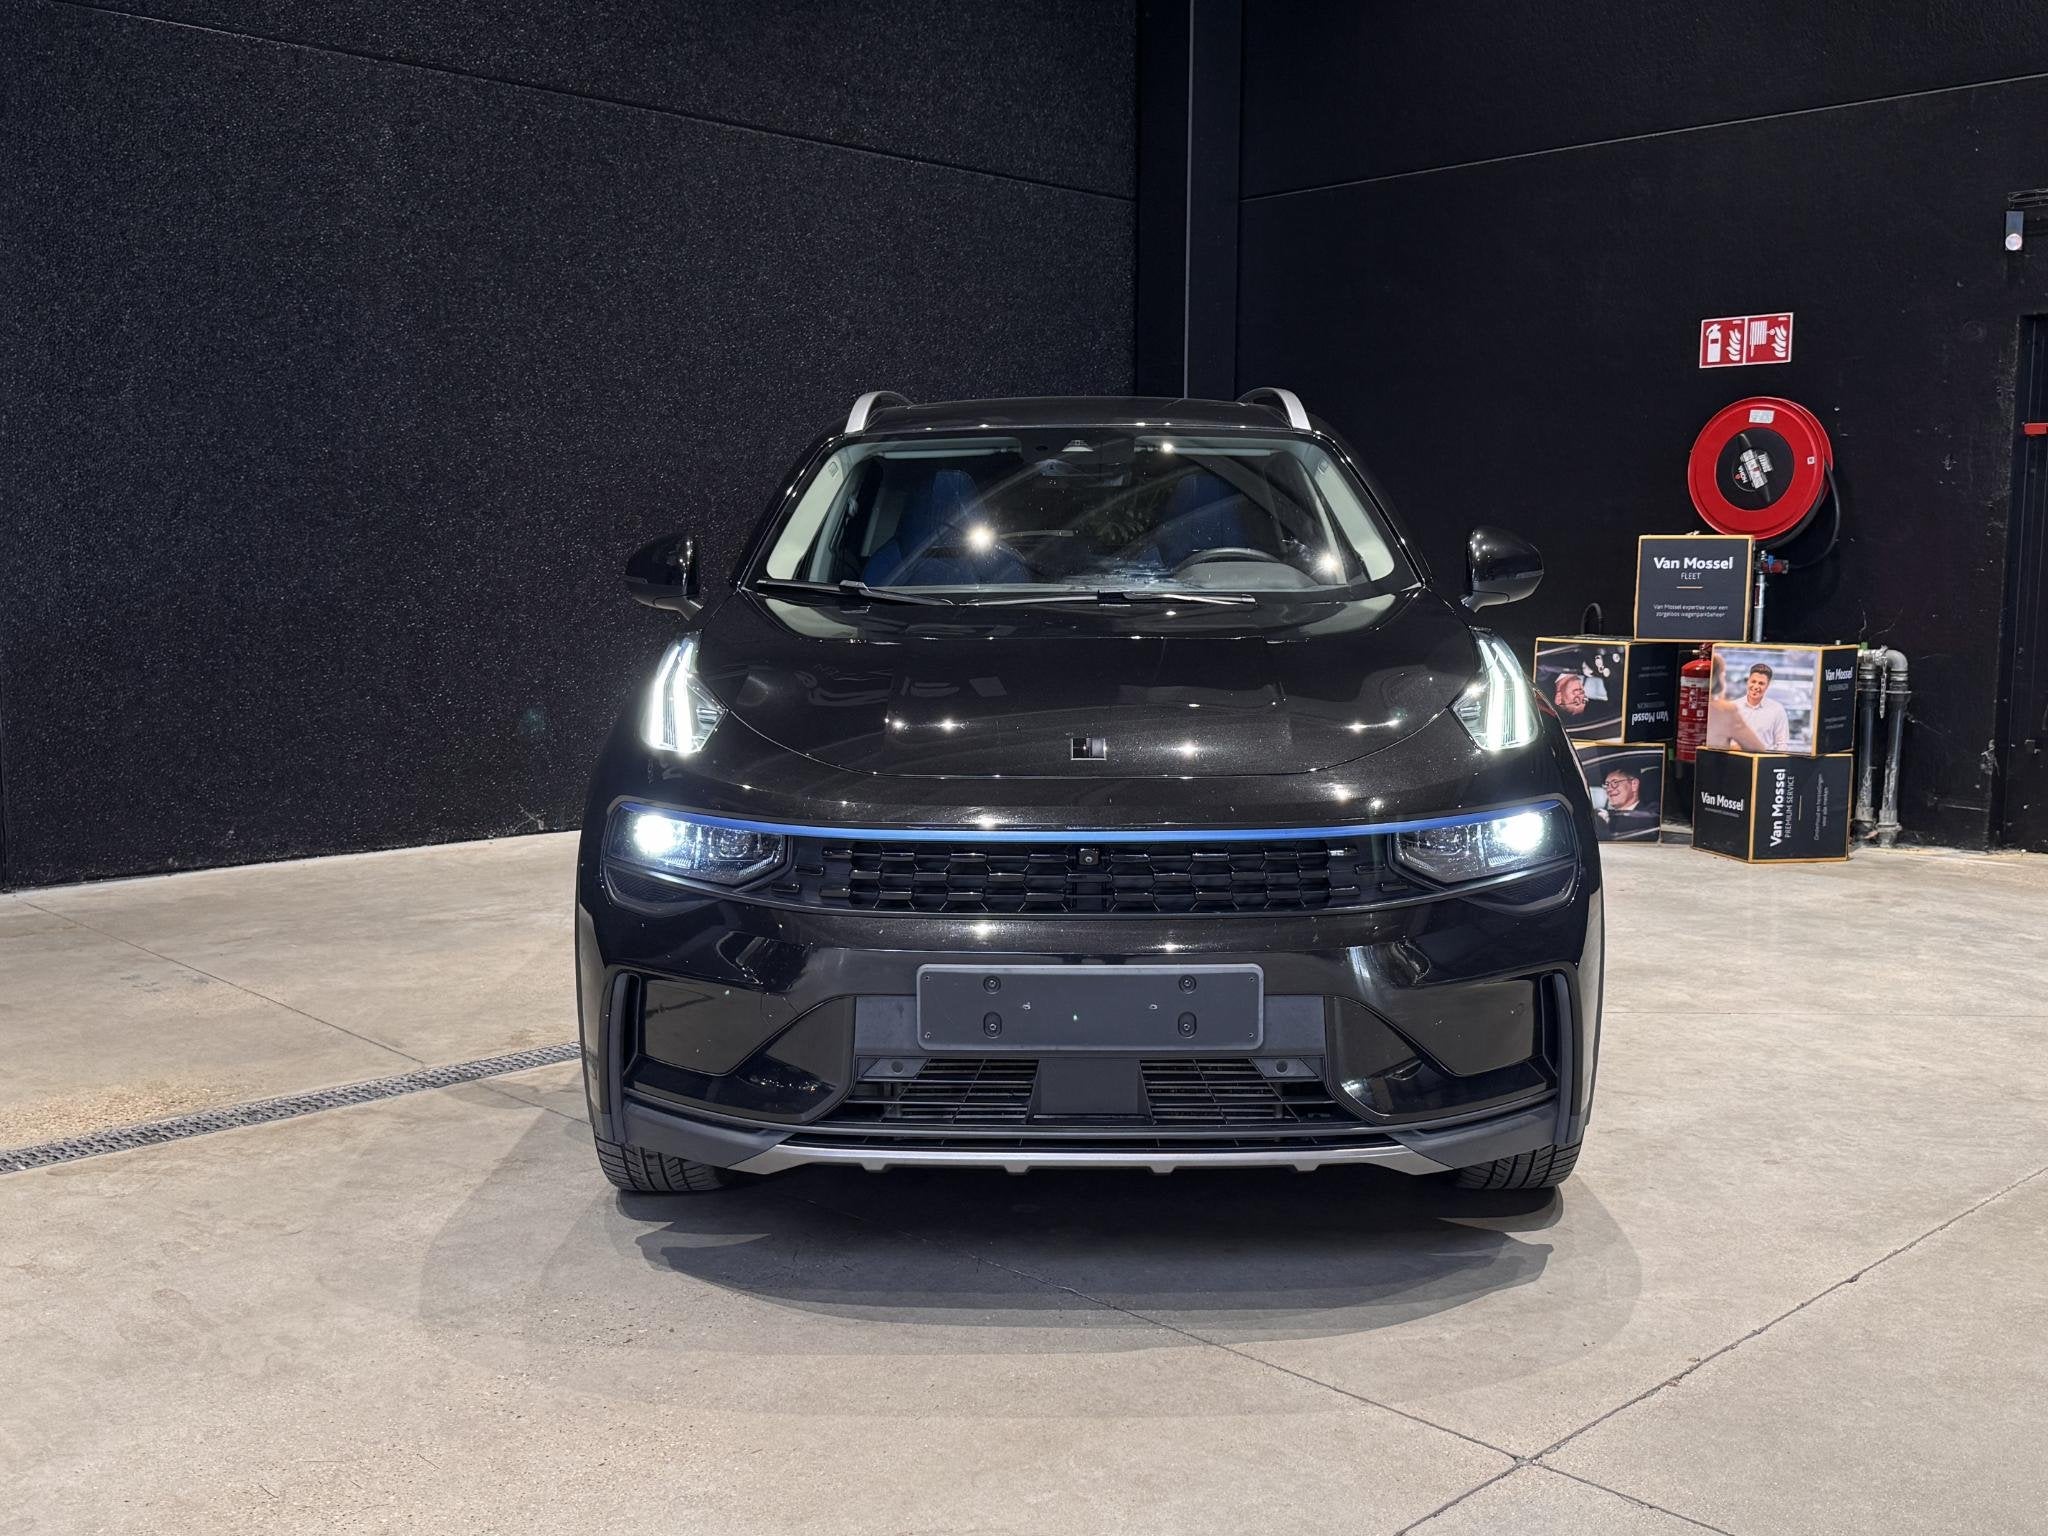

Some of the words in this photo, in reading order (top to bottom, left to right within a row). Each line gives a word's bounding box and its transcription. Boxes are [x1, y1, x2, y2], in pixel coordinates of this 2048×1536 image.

[1653, 557, 1680, 569] Van
[1683, 556, 1734, 569] Mossel
[1680, 572, 1702, 580] FLEET
[1825, 669, 1835, 681] Van
[1835, 667, 1853, 680] Mossel
[1632, 711, 1655, 726] Mossel
[1656, 710, 1669, 722] Van
[1771, 768, 1786, 817] Mossel
[1787, 776, 1795, 804] SERVICE
[1700, 791, 1715, 805] Van
[1716, 794, 1744, 811] Mossel
[1784, 805, 1793, 838] PREMIUM
[1769, 820, 1783, 847] Van
